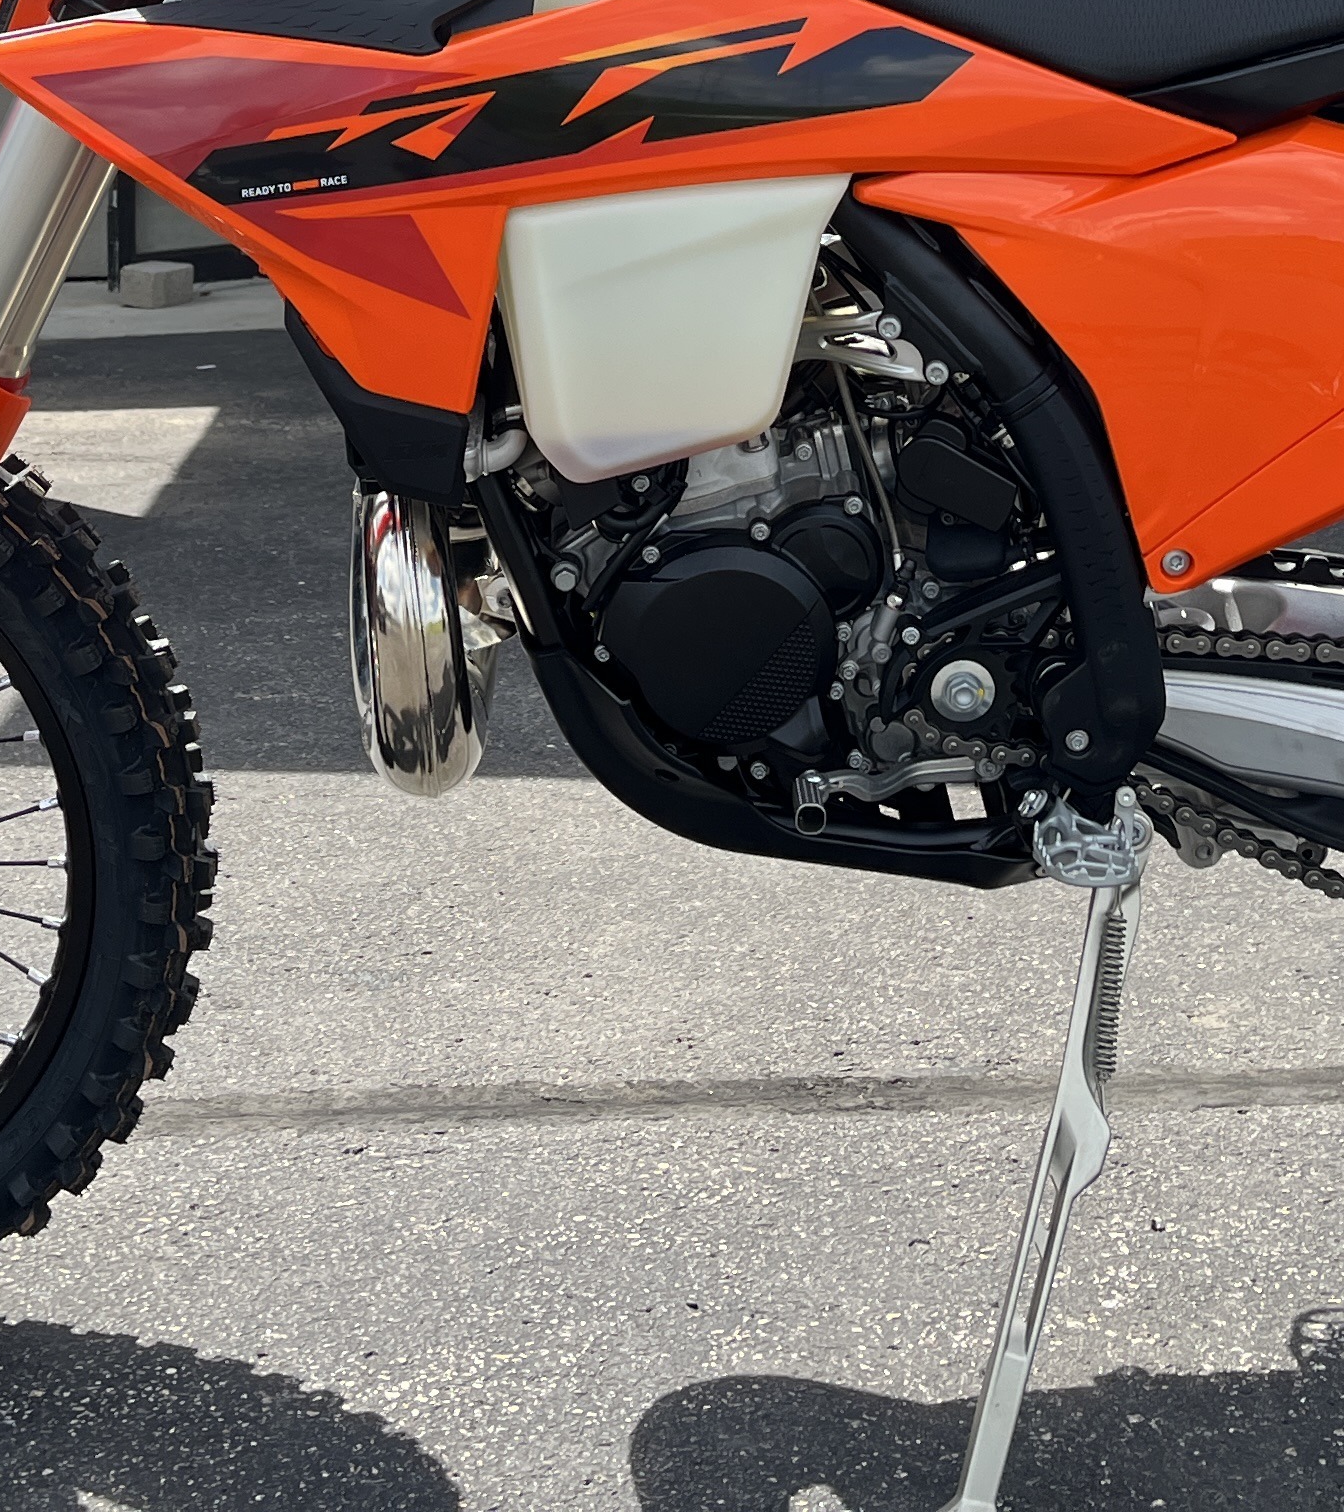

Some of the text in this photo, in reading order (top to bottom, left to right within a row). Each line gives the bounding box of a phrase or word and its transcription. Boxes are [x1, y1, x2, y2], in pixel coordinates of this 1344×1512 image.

[241, 175, 347, 198] READY TO RACE
